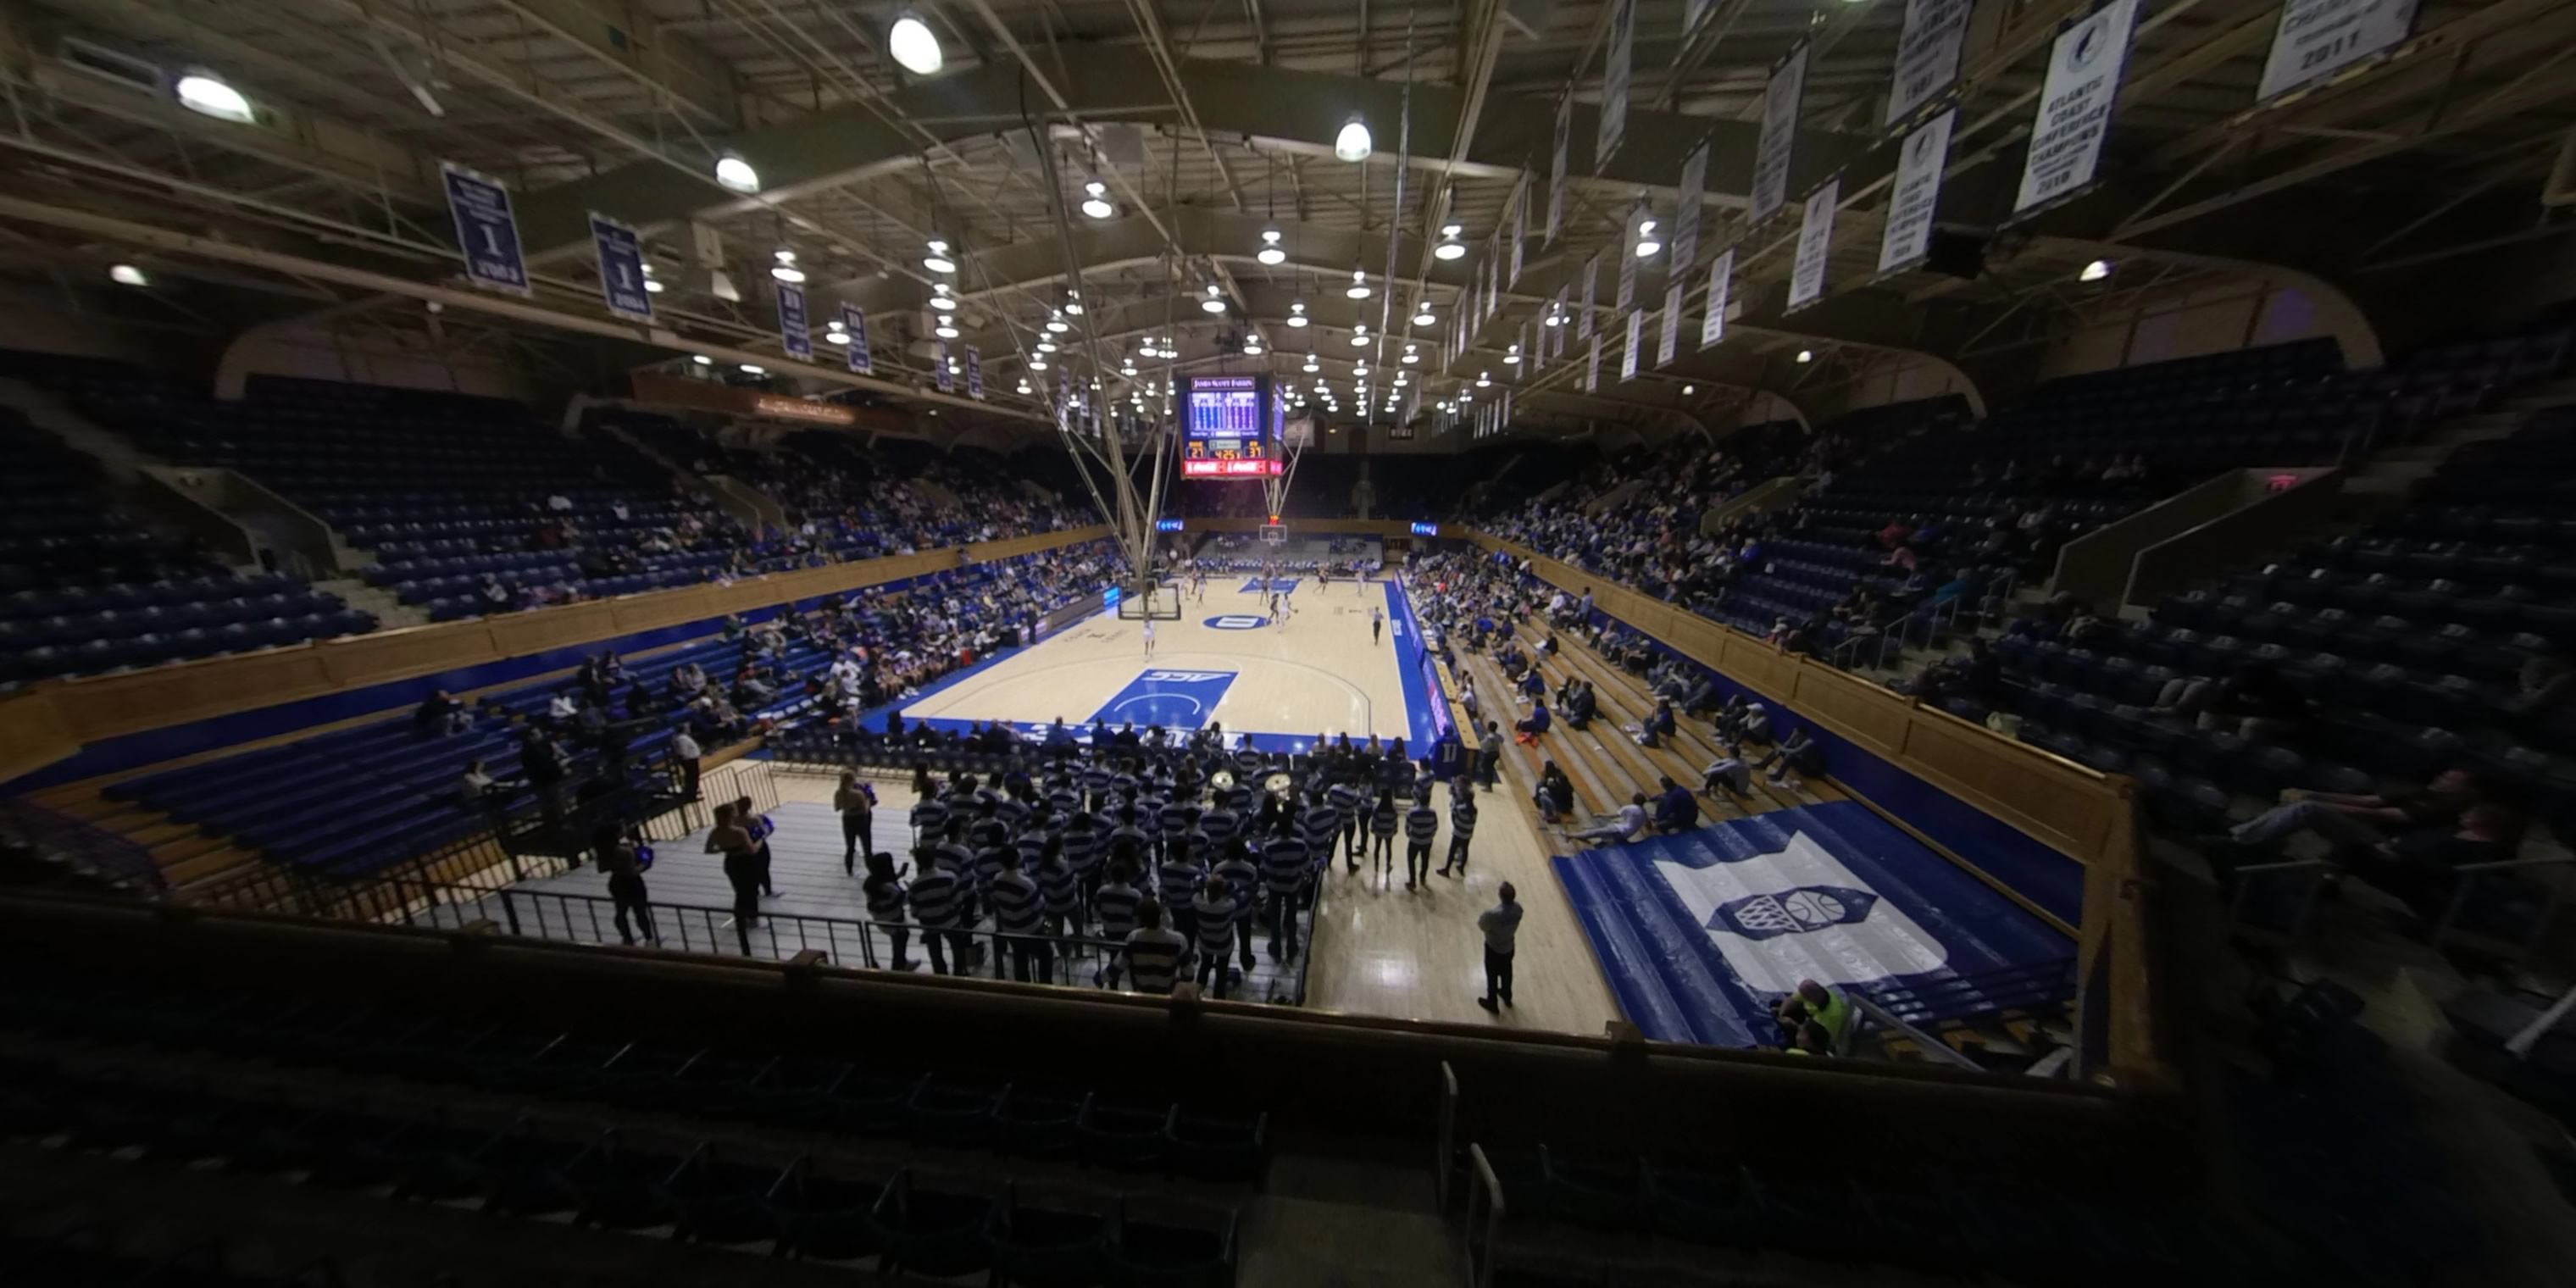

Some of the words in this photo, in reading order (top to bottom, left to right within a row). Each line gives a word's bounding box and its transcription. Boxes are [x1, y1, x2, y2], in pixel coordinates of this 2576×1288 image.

[2301, 29, 2361, 70] 2011
[480, 224, 504, 258] 1
[616, 262, 635, 291] 1
[1249, 447, 1262, 458] 37
